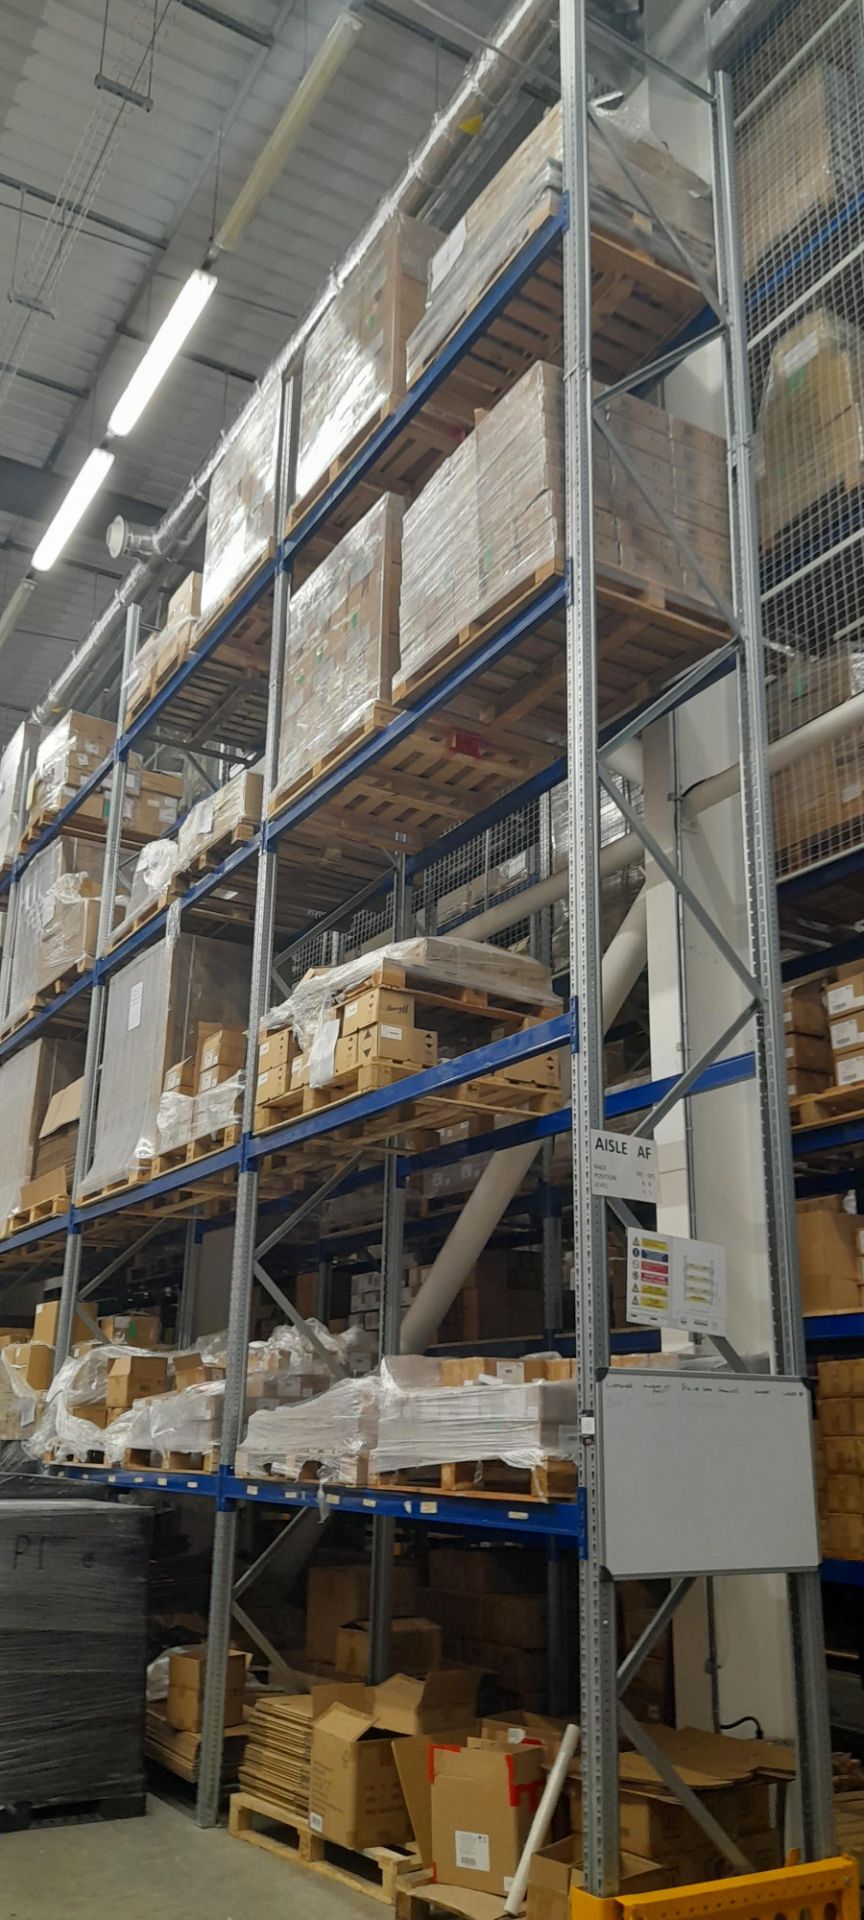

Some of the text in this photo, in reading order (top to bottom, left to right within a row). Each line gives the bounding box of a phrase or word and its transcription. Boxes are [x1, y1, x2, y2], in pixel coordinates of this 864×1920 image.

[595, 1137, 652, 1159] AISLE AF
[594, 1172, 617, 1181] POSITION
